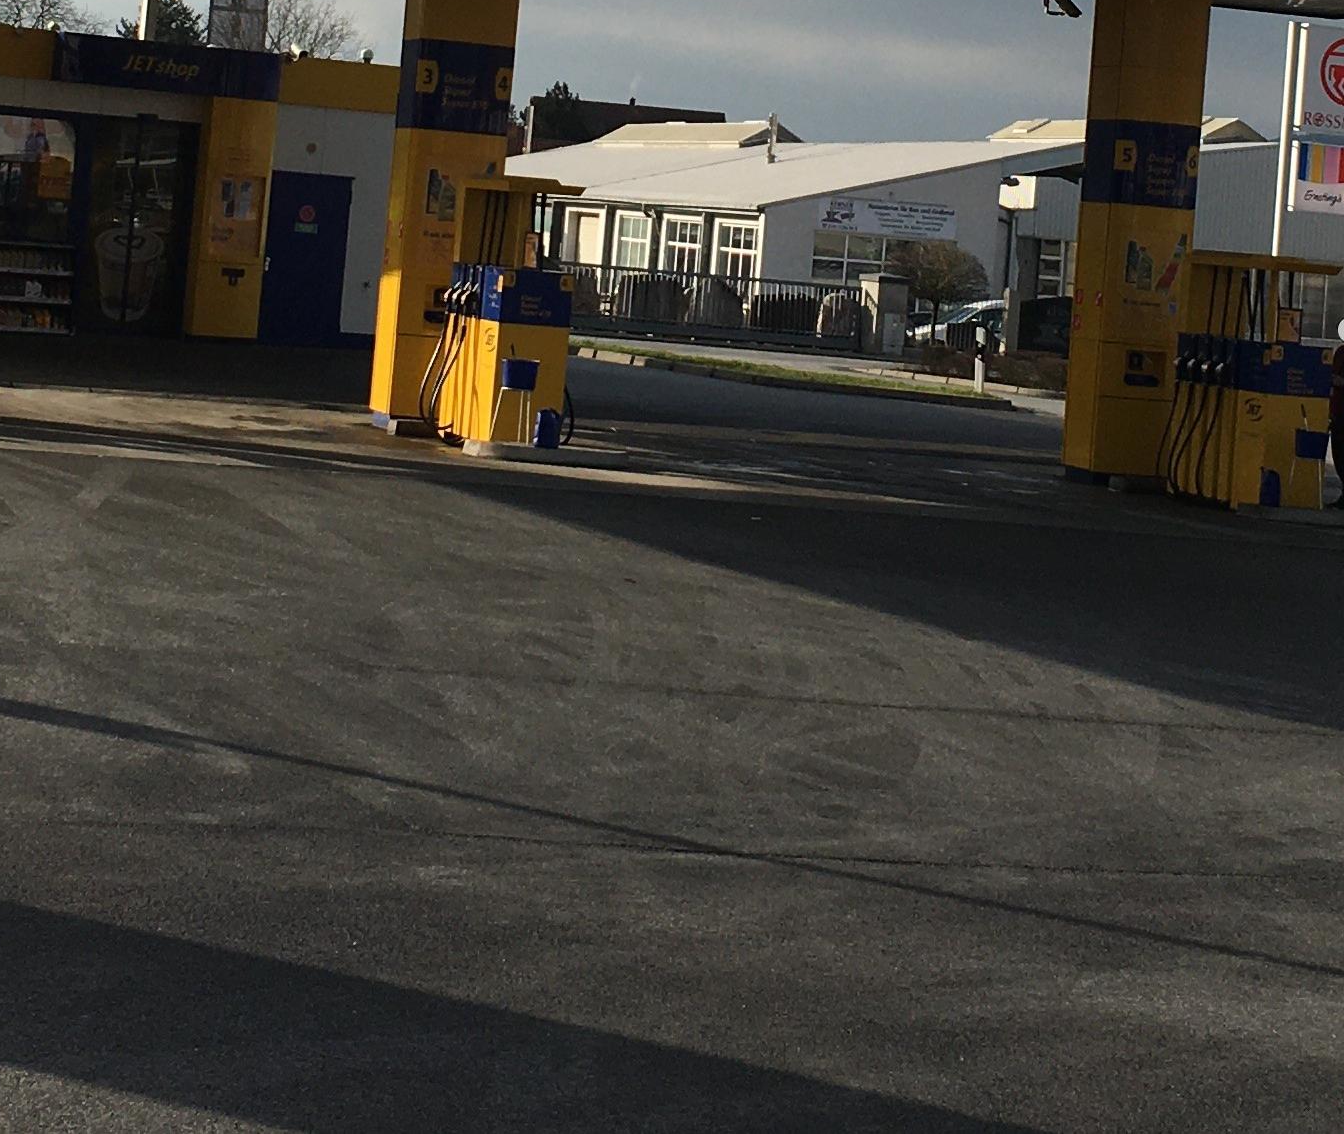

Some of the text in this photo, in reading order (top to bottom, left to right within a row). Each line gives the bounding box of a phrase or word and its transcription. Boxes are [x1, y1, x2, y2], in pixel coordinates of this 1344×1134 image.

[423, 68, 433, 85] 3
[498, 75, 509, 92] 4
[1123, 147, 1133, 163] 5
[1189, 153, 1198, 169] 6
